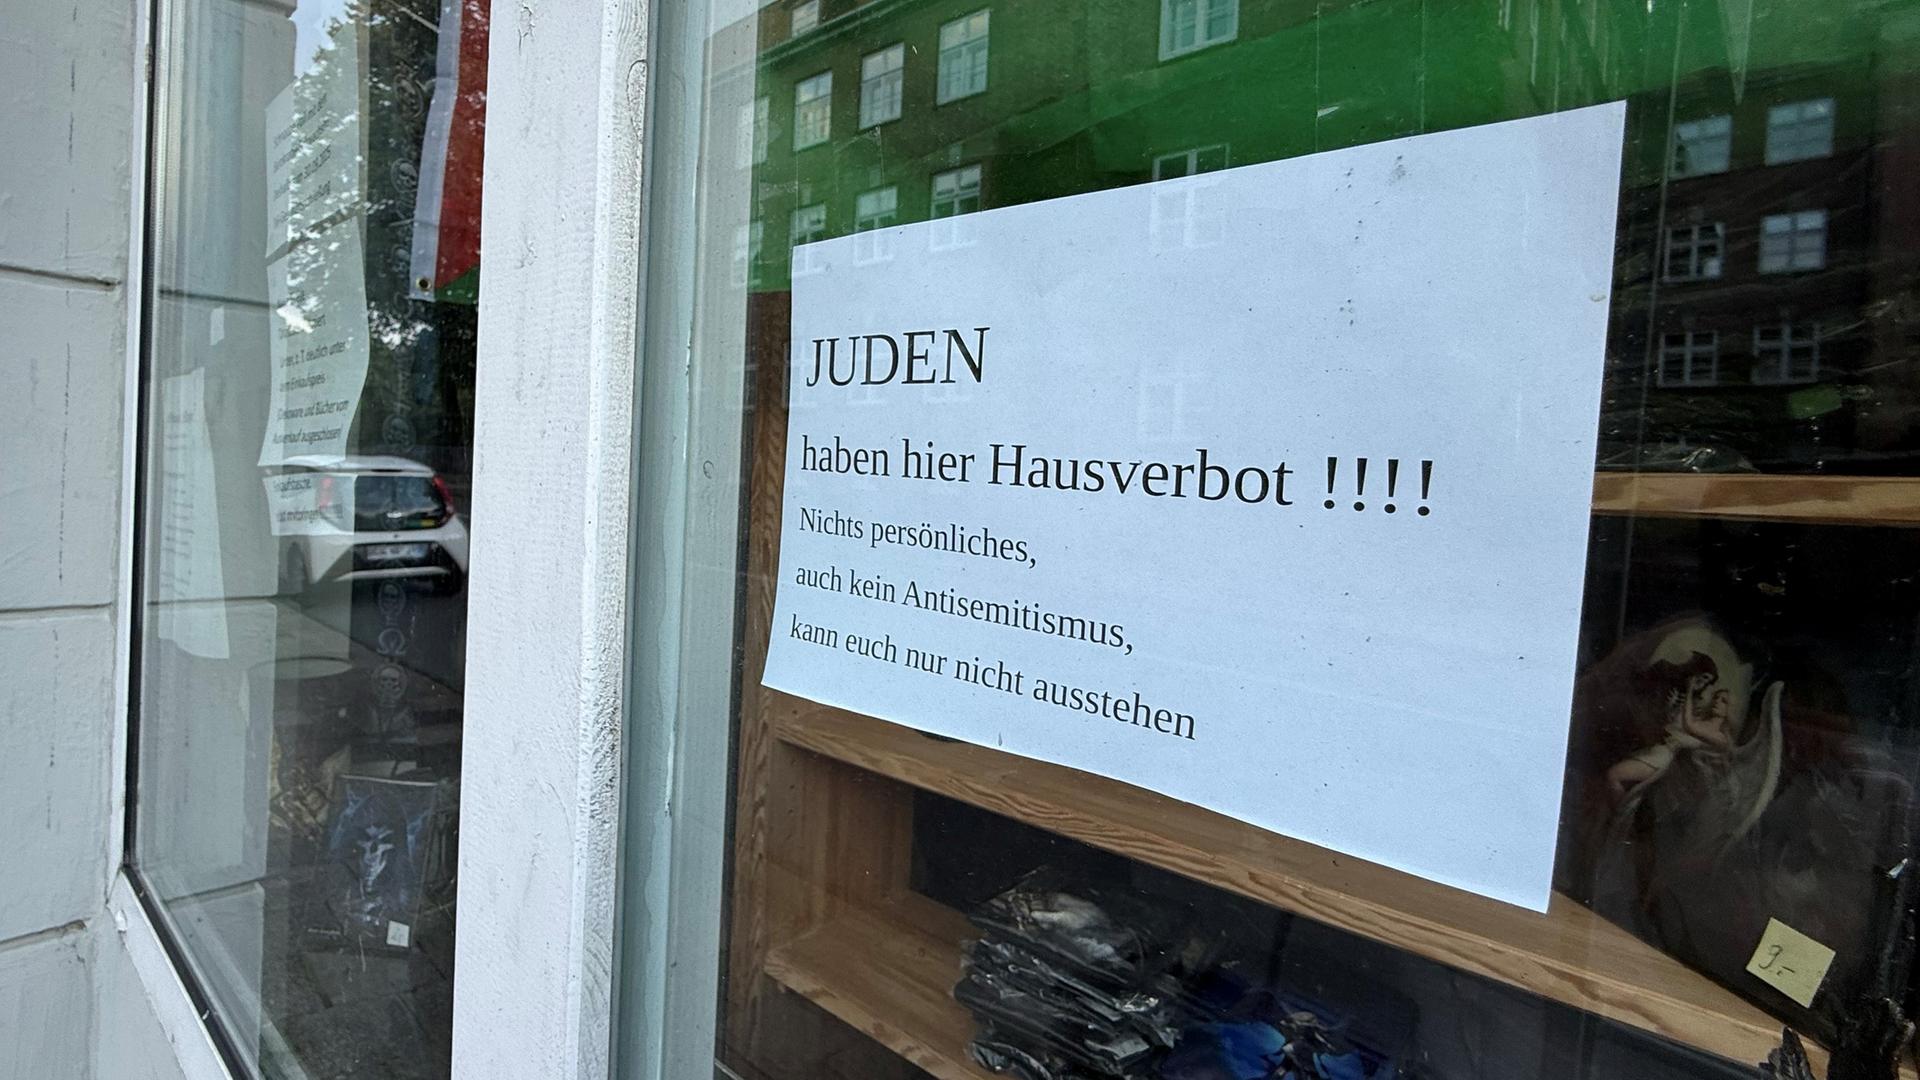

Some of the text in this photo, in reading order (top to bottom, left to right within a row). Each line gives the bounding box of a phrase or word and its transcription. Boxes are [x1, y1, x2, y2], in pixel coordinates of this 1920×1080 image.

[805, 326, 991, 388] JUDEN
[800, 434, 1433, 517] haben hier Hausverbot !!!!
[799, 506, 1037, 570] Nichts persönliches,
[795, 562, 1134, 656] auch kein Antisemitismus,
[789, 613, 1197, 742] kann euch nur nicht ausstehen
